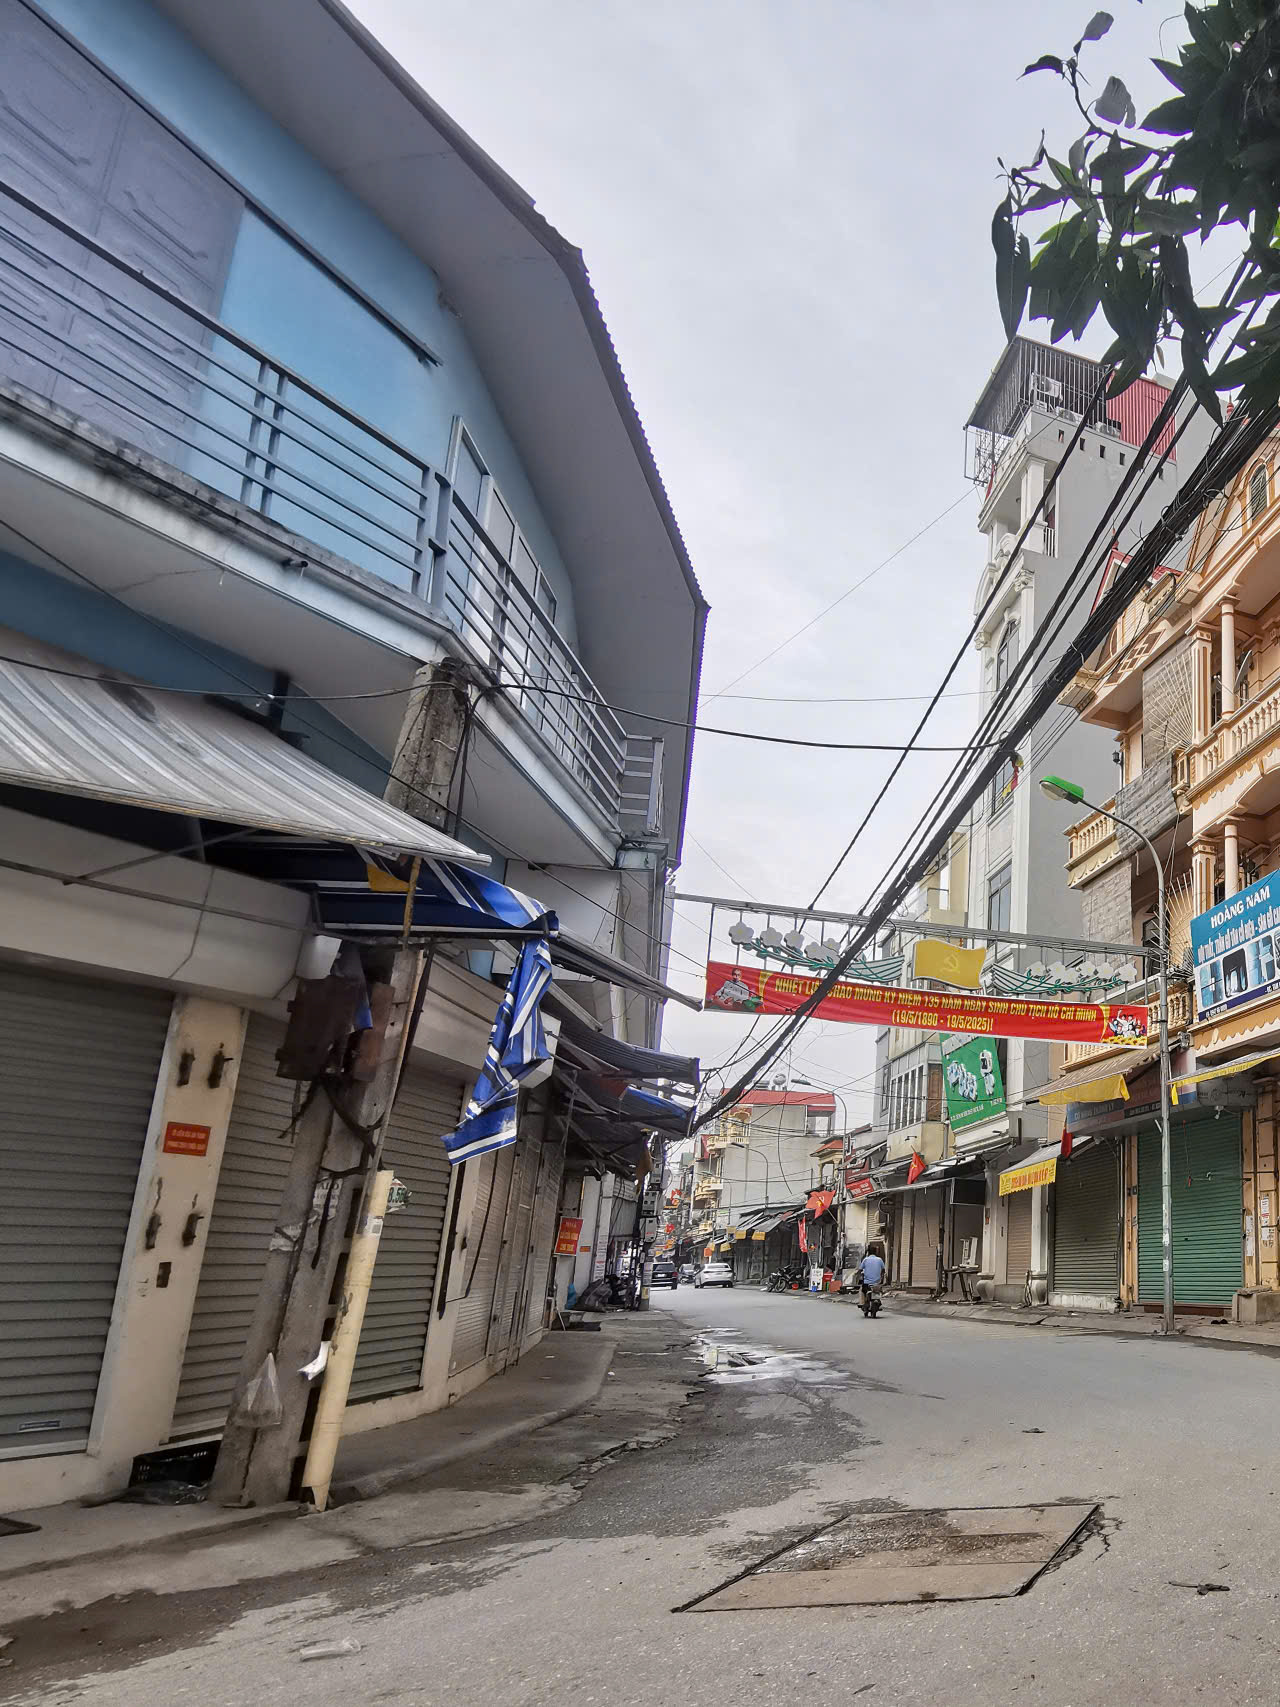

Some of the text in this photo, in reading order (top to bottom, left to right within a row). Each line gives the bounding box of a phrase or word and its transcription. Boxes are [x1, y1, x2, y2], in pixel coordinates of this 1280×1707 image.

[1210, 885, 1271, 929] HOÀNG NAM
[775, 978, 803, 997] NHIỆT
[898, 990, 921, 1008] NIỆM
[924, 996, 940, 1009] 135
[988, 1001, 1009, 1014] SINH
[1028, 1004, 1047, 1020] TỊCH
[1076, 1008, 1097, 1022] MINH
[892, 1009, 938, 1026] (19/5/1890
[946, 1014, 994, 1032] 19/5/2025)!
